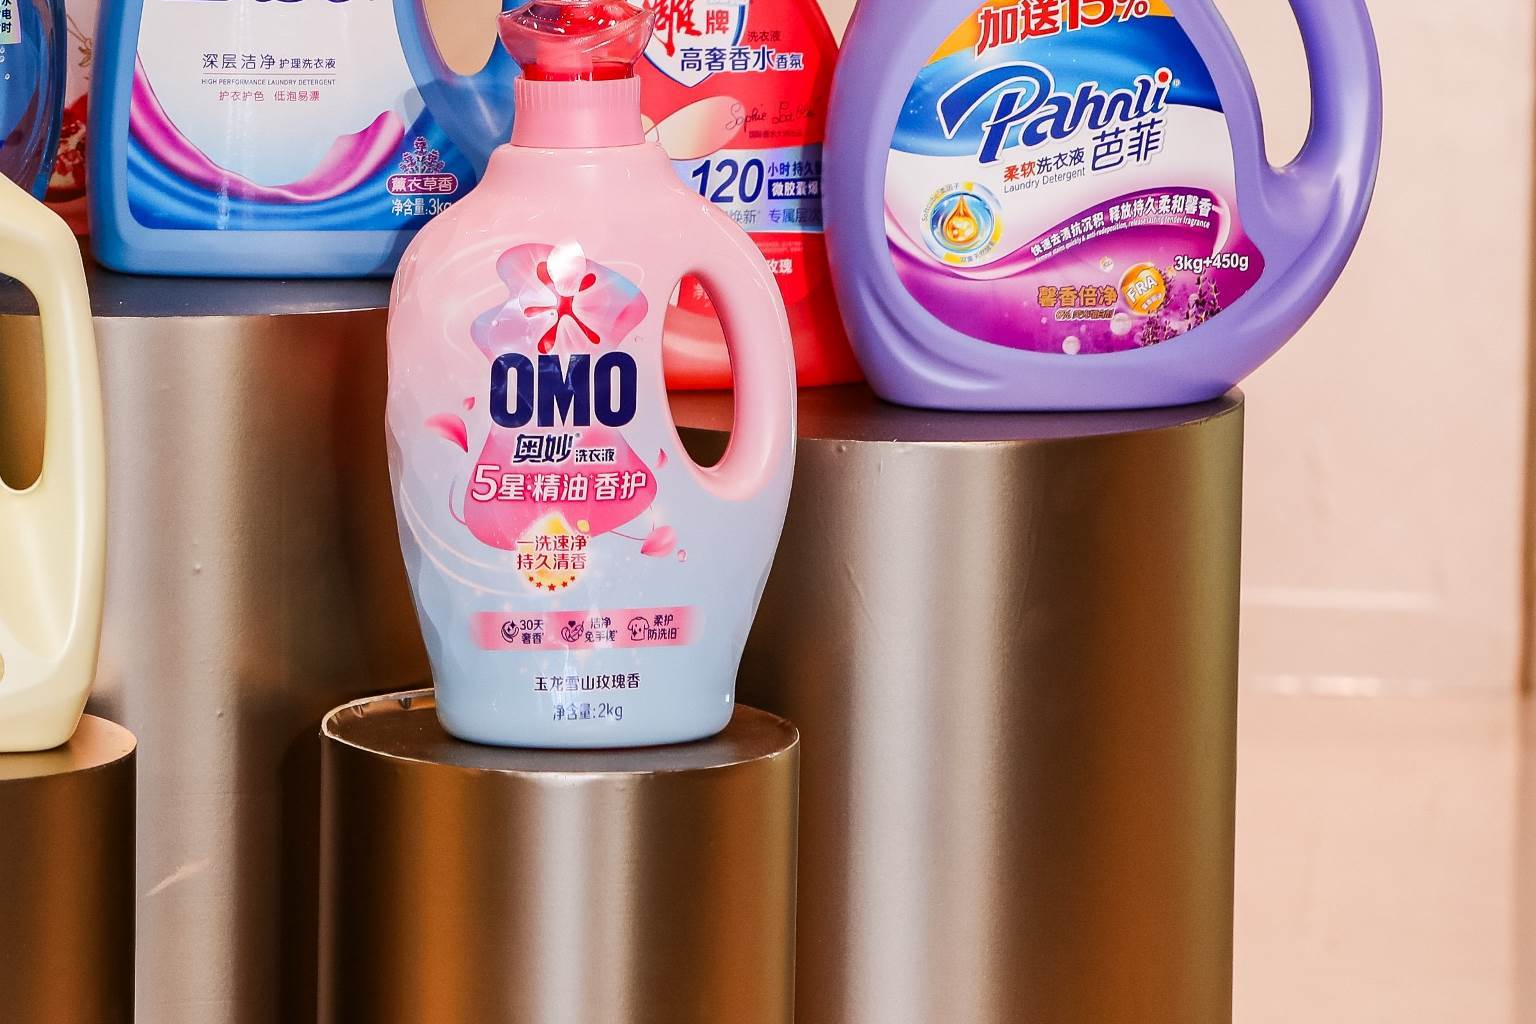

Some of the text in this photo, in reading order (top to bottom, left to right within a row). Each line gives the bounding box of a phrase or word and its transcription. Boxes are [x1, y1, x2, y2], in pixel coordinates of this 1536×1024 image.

[219, 91, 264, 102] 护衣护色
[1092, 121, 1162, 169] 芭菲
[1004, 147, 1084, 182] 柔软洗衣液
[691, 158, 764, 204] 120
[1003, 167, 1086, 193] Laundry Detergent
[1174, 254, 1250, 273] 3kg+450g
[489, 351, 637, 428] OMO
[513, 434, 615, 463] 奥妙 洗衣液
[516, 534, 586, 552] 一洗速净
[516, 553, 586, 570] 持久清香
[520, 619, 544, 631] 30天
[653, 614, 674, 627] 柔护
[534, 673, 641, 691] 玉龙雪山玫瑰香
